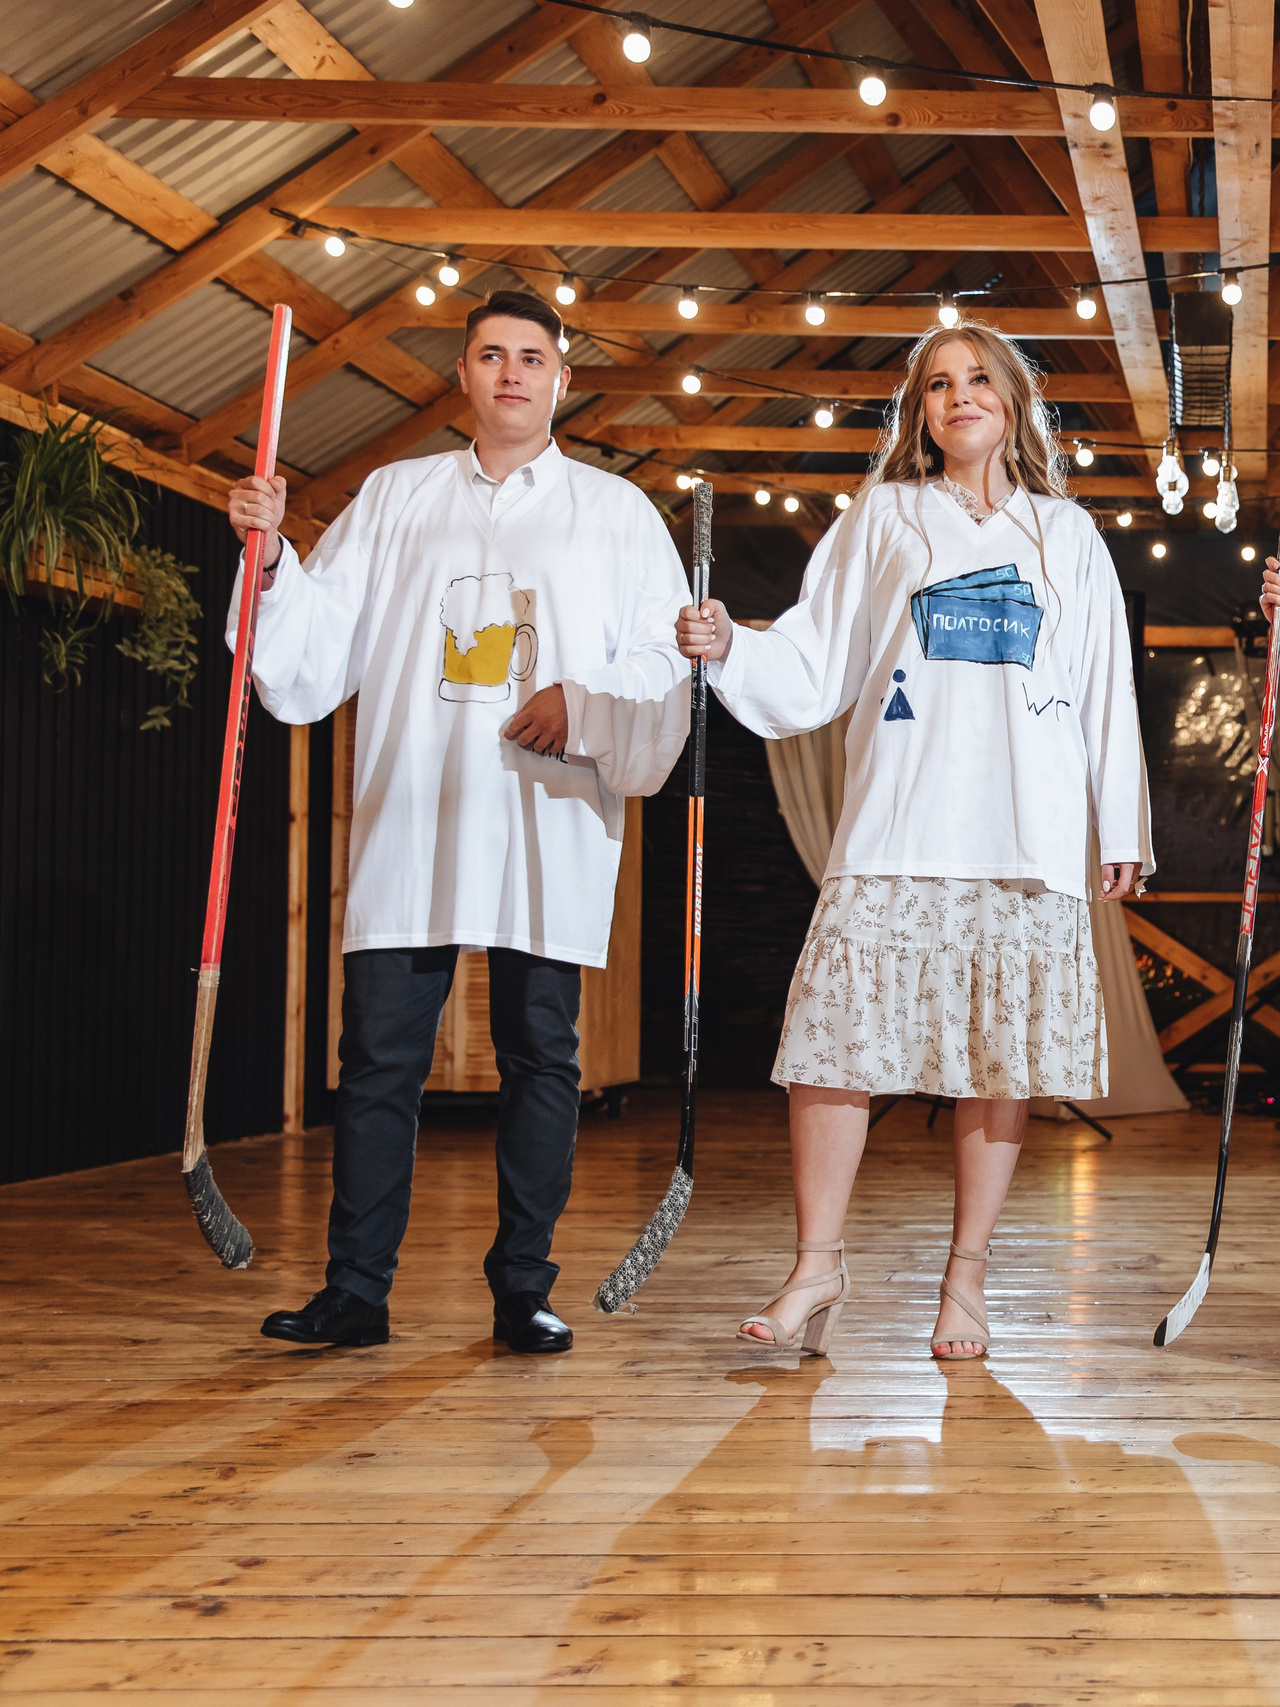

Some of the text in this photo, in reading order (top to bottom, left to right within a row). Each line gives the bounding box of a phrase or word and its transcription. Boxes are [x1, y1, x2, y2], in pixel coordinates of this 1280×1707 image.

[996, 567, 1014, 580] 50
[1014, 584, 1031, 596] 50
[932, 613, 1031, 640] ПОЛТОСИК
[1240, 810, 1263, 934] VAPOR
[694, 842, 704, 937] NORDWAY
